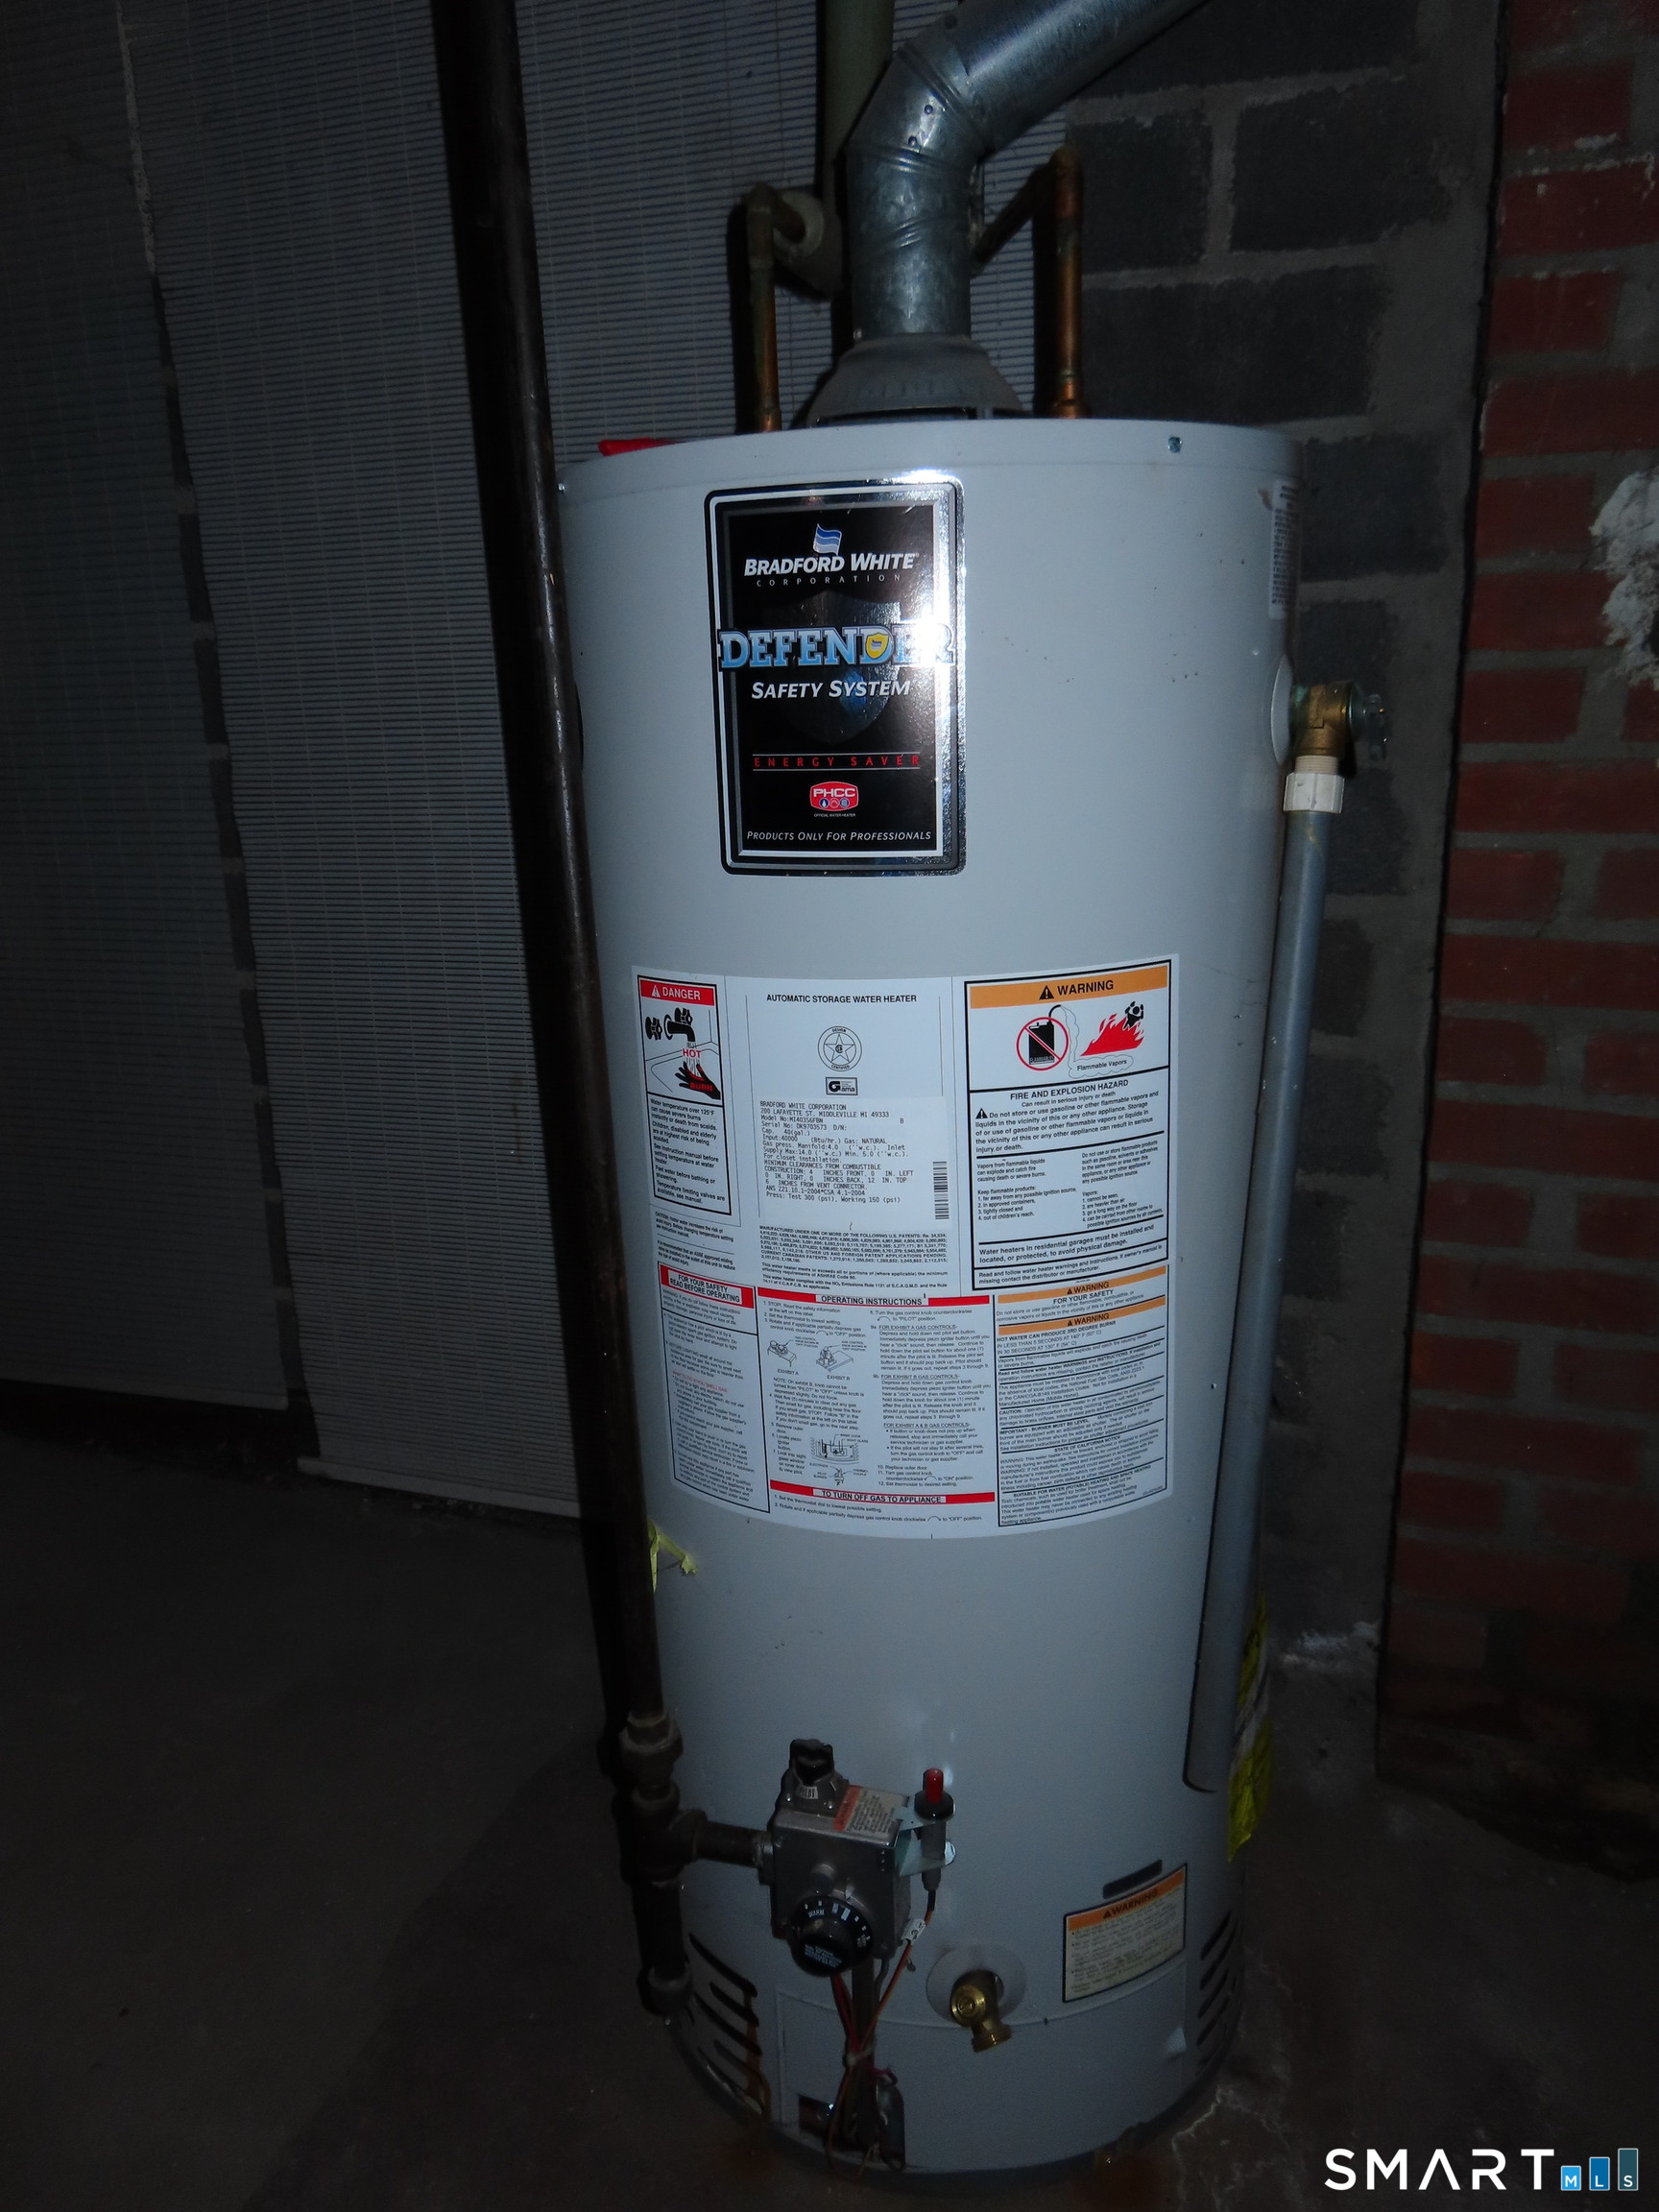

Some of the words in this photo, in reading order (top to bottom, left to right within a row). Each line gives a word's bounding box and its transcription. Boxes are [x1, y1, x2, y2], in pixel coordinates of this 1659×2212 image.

[744, 556, 844, 576] BRADFORD
[851, 553, 915, 571] WHITE
[757, 575, 901, 587] CORPORATION
[752, 682, 823, 699] SAFETY
[829, 680, 910, 697] SYSTEM
[755, 757, 834, 767] ENERGY
[851, 755, 919, 766] SAVER
[813, 788, 855, 797] PHCC
[747, 831, 794, 840] PRODUCTS
[798, 831, 823, 841] ONLY
[827, 831, 847, 841] FOR
[850, 831, 931, 841] PROFESSIONALS
[662, 987, 701, 1000] DANGER
[1058, 980, 1114, 996] WARNING
[767, 994, 810, 1002] AUTOMATIC
[812, 995, 851, 1003] STORAGE
[683, 1048, 701, 1058] HOT
[1077, 1062, 1107, 1070] Flammable
[1109, 1059, 1127, 1068] Vapors
[1051, 1085, 1095, 1096] EXPLOSION
[1098, 1079, 1128, 1090] HAZARD
[1050, 1105, 1075, 1114] gasoline
[1101, 1097, 1129, 1106] flammable
[670, 1278, 683, 1286] READ
[685, 1284, 705, 1294] BEFORE
[707, 1289, 739, 1302] OPERATING
[690, 1278, 704, 1286] YOUR
[706, 1283, 728, 1292] SAFETY
[1074, 1282, 1109, 1293] WARNING
[1089, 1289, 1114, 1299] SAFETY
[821, 1296, 863, 1305] OPERATING
[1074, 1313, 1109, 1325] WARNING
[1111, 1888, 1158, 1915] WARNING
